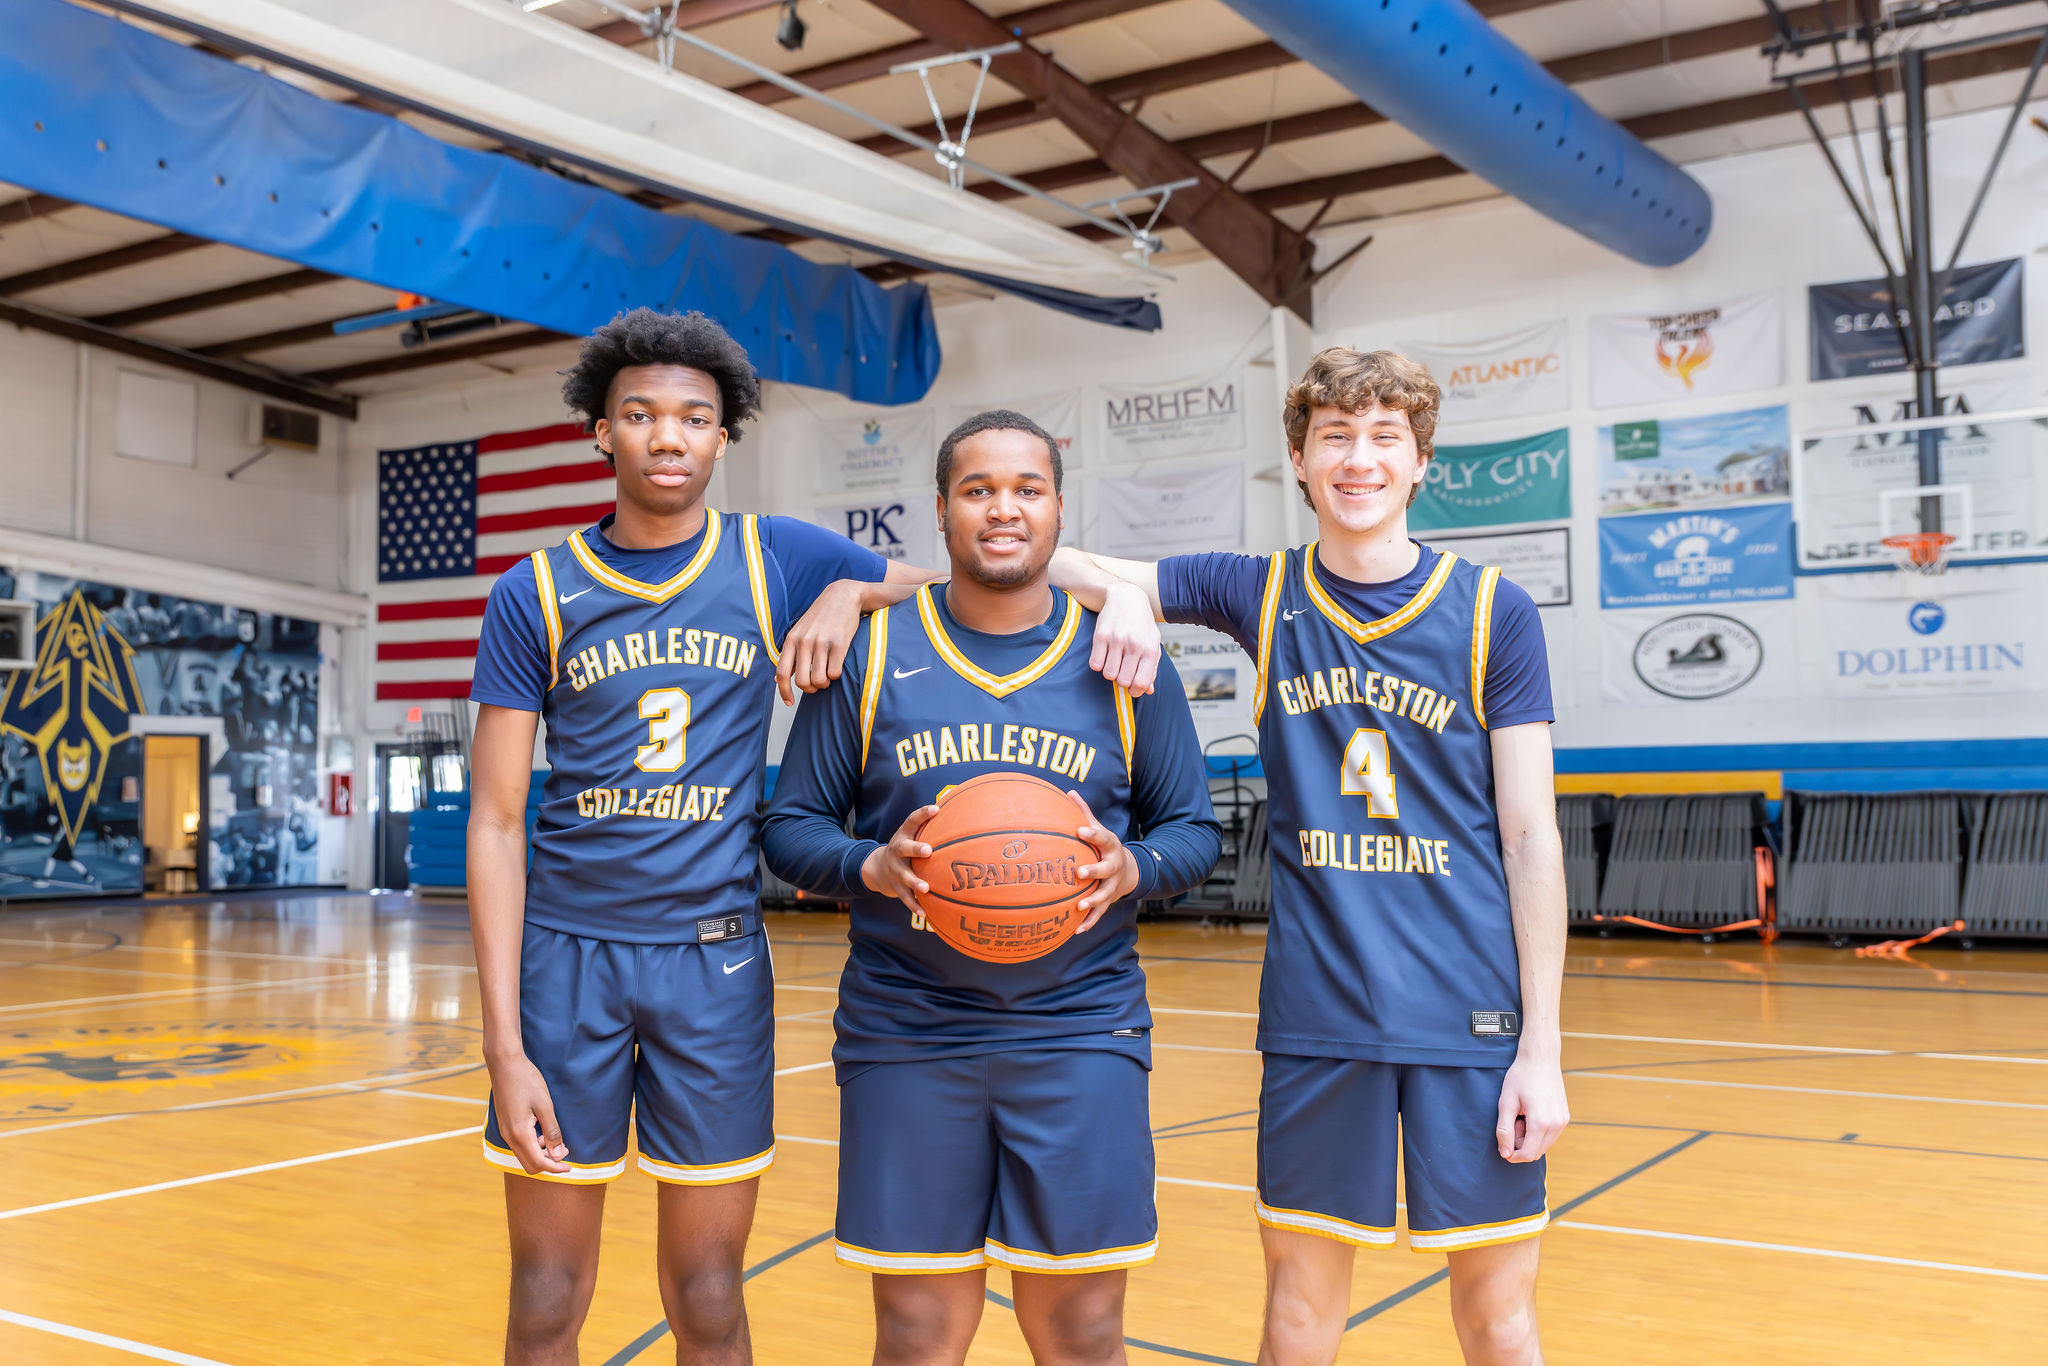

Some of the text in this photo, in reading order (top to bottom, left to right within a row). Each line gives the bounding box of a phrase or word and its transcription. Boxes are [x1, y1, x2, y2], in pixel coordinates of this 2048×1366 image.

[1449, 353, 1560, 387] ATLANTIC
[1107, 384, 1236, 428] MRHFM
[1489, 448, 1566, 485] CITY
[845, 504, 905, 547] PK
[566, 627, 757, 692] CHARLESTON
[1837, 642, 2025, 677] DOLPHIN
[1277, 666, 1457, 735] CHARLESTON
[634, 687, 691, 773] 3
[896, 723, 1097, 783] CHARLESTON
[1340, 727, 1400, 820] 4
[576, 783, 731, 821] COLLEGIATE
[1298, 829, 1452, 877] COLLEGIATE
[951, 855, 1076, 892] SPALDING
[729, 922, 737, 932] S
[959, 910, 1070, 940] LEGACY
[1505, 1018, 1511, 1029] L
